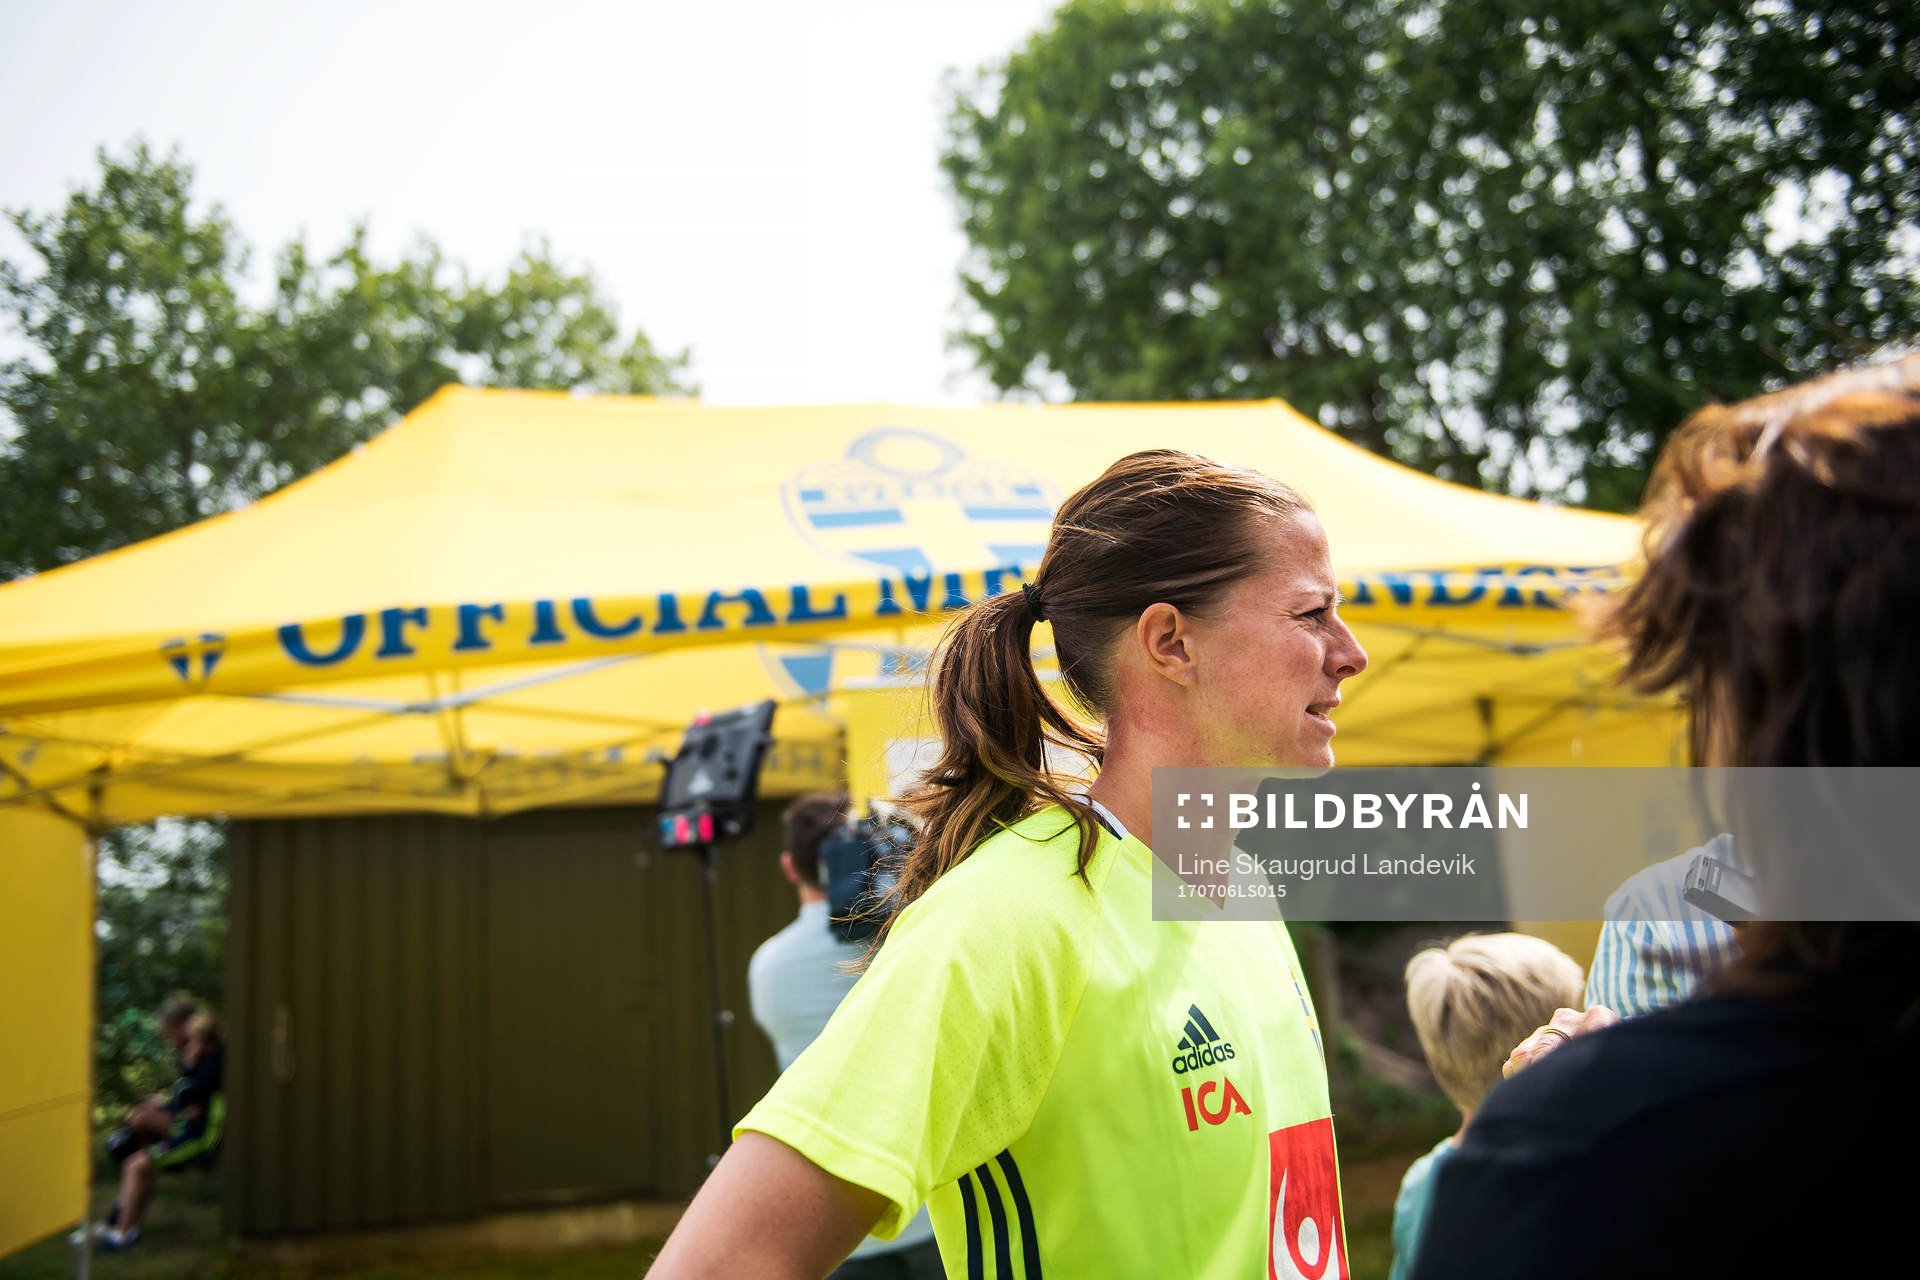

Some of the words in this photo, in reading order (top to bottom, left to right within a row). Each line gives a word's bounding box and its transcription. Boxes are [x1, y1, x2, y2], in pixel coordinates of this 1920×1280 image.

[277, 583, 847, 669] OFFICIAL
[1172, 1042, 1236, 1075] adidas
[1181, 1075, 1253, 1132] ICA
